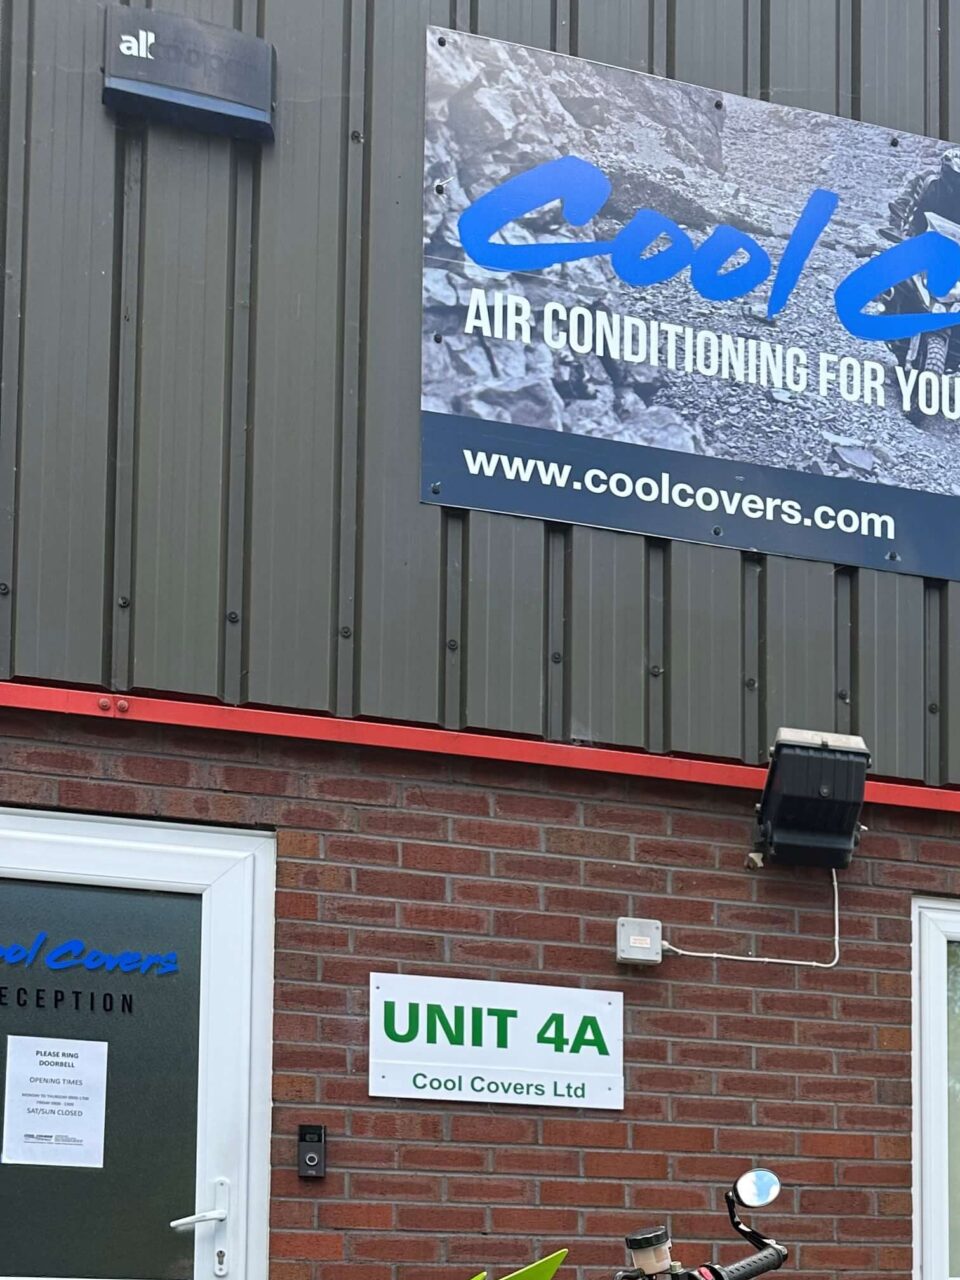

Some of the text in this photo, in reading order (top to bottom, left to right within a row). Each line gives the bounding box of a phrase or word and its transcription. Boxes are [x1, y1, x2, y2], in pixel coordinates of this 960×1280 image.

[458, 155, 839, 320] Cool
[464, 287, 531, 344] AIR
[543, 302, 807, 394] CONDITIONING
[819, 352, 885, 407] FOR
[463, 448, 895, 540] www.coolcovers.com
[0, 931, 179, 976] ol Covers
[0, 986, 133, 1014] ECEPTION
[383, 1000, 610, 1056] UNIT 4A
[36, 1050, 60, 1058] PLEASE
[39, 1060, 75, 1068] DOORBELL
[29, 1076, 83, 1086] OPENING TIMES
[412, 1073, 585, 1099] Cool Covers Ltd
[27, 1107, 83, 1117] SAT/SUN CLOSED
